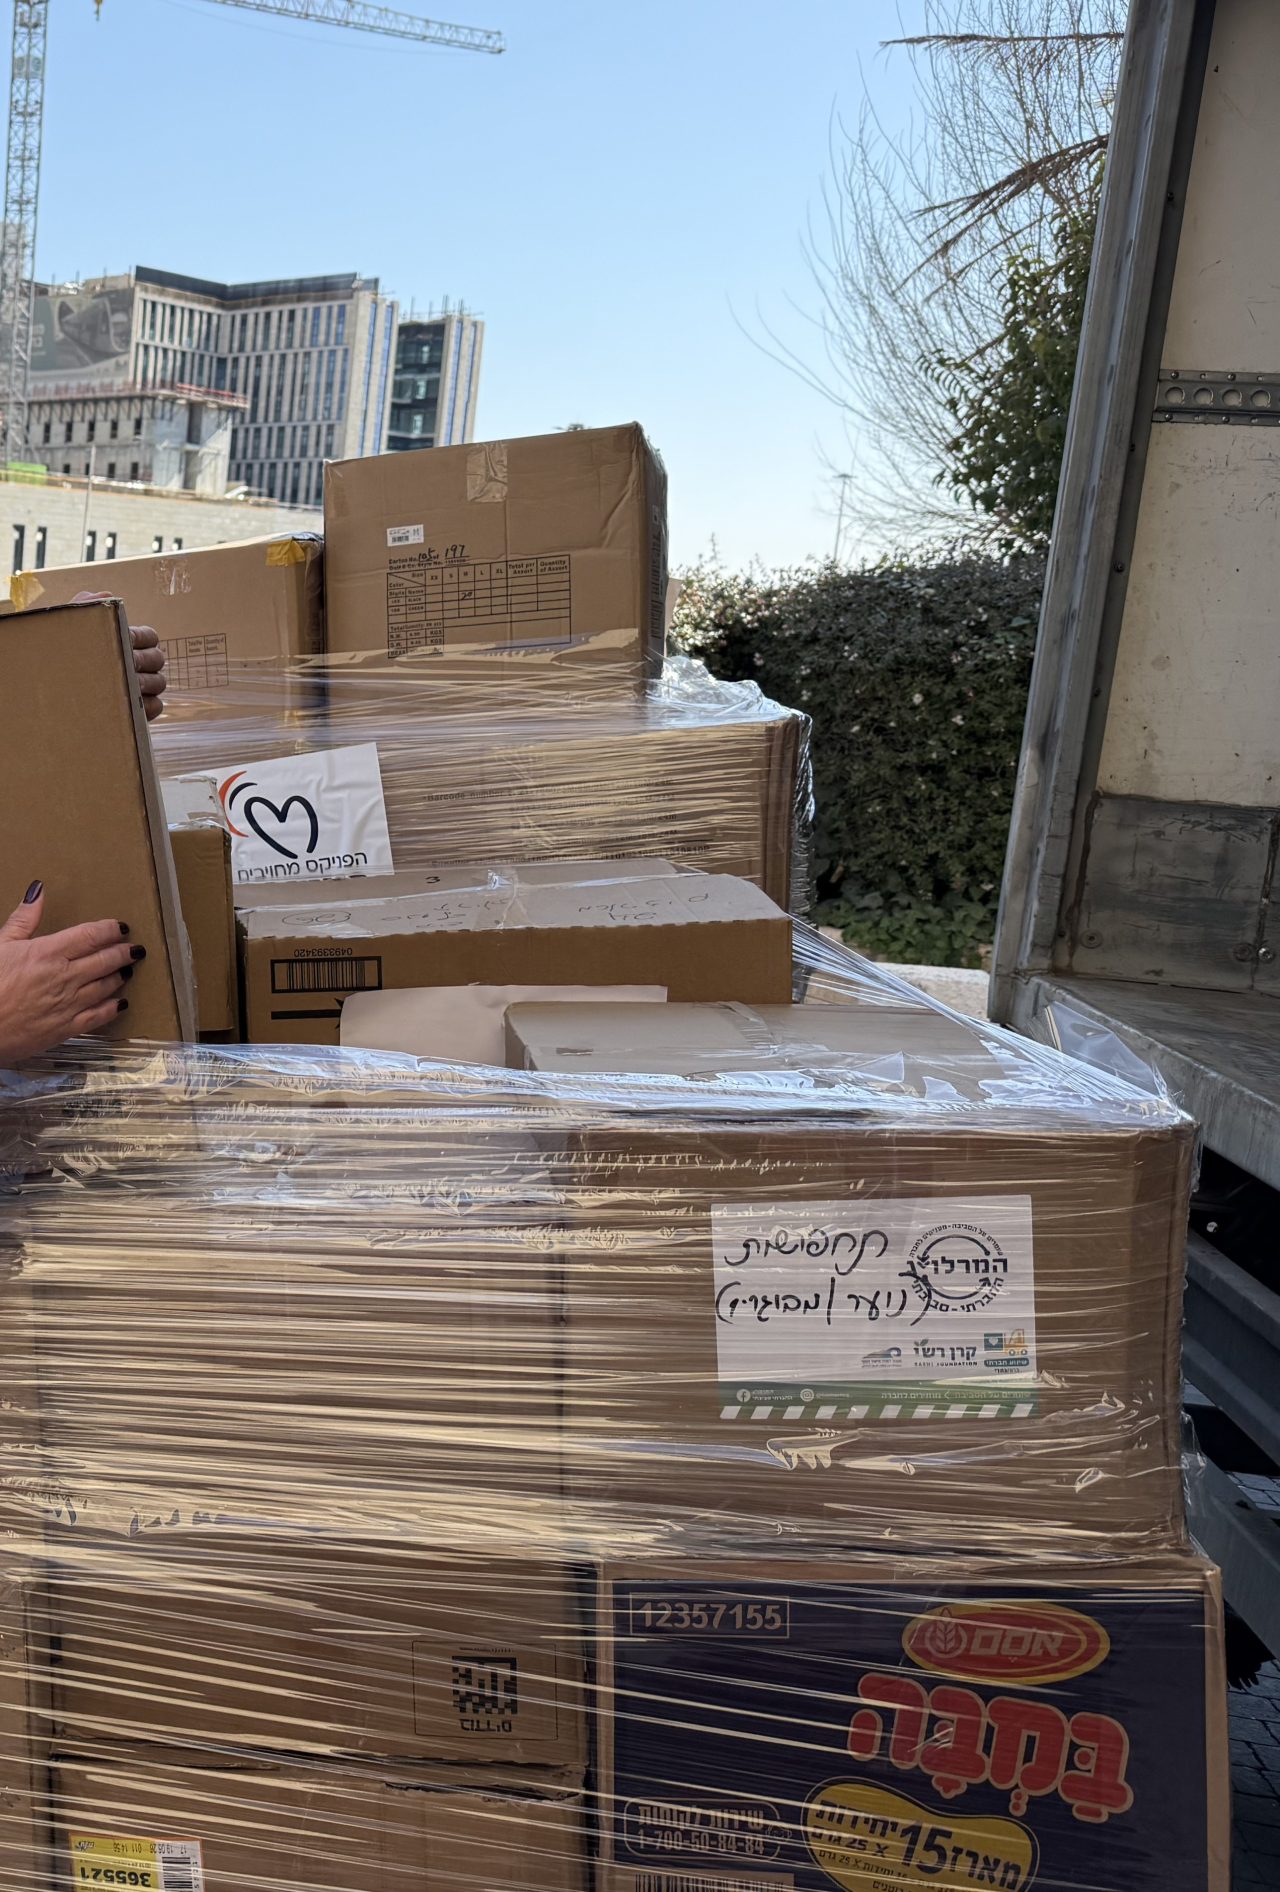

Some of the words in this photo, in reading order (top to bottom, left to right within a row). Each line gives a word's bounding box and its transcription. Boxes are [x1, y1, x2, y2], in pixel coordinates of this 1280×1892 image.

[444, 544, 466, 559] 197
[539, 559, 566, 567] Quantity
[237, 861, 300, 882] מחויבים
[305, 852, 368, 874] הפניקס
[724, 1228, 889, 1276] תחפושות
[950, 1346, 977, 1361] קרן
[638, 1601, 782, 1631] 12357155
[900, 1820, 953, 1875] 15
[80, 1867, 153, 1888] 365521
[950, 1845, 1022, 1890] מארז
